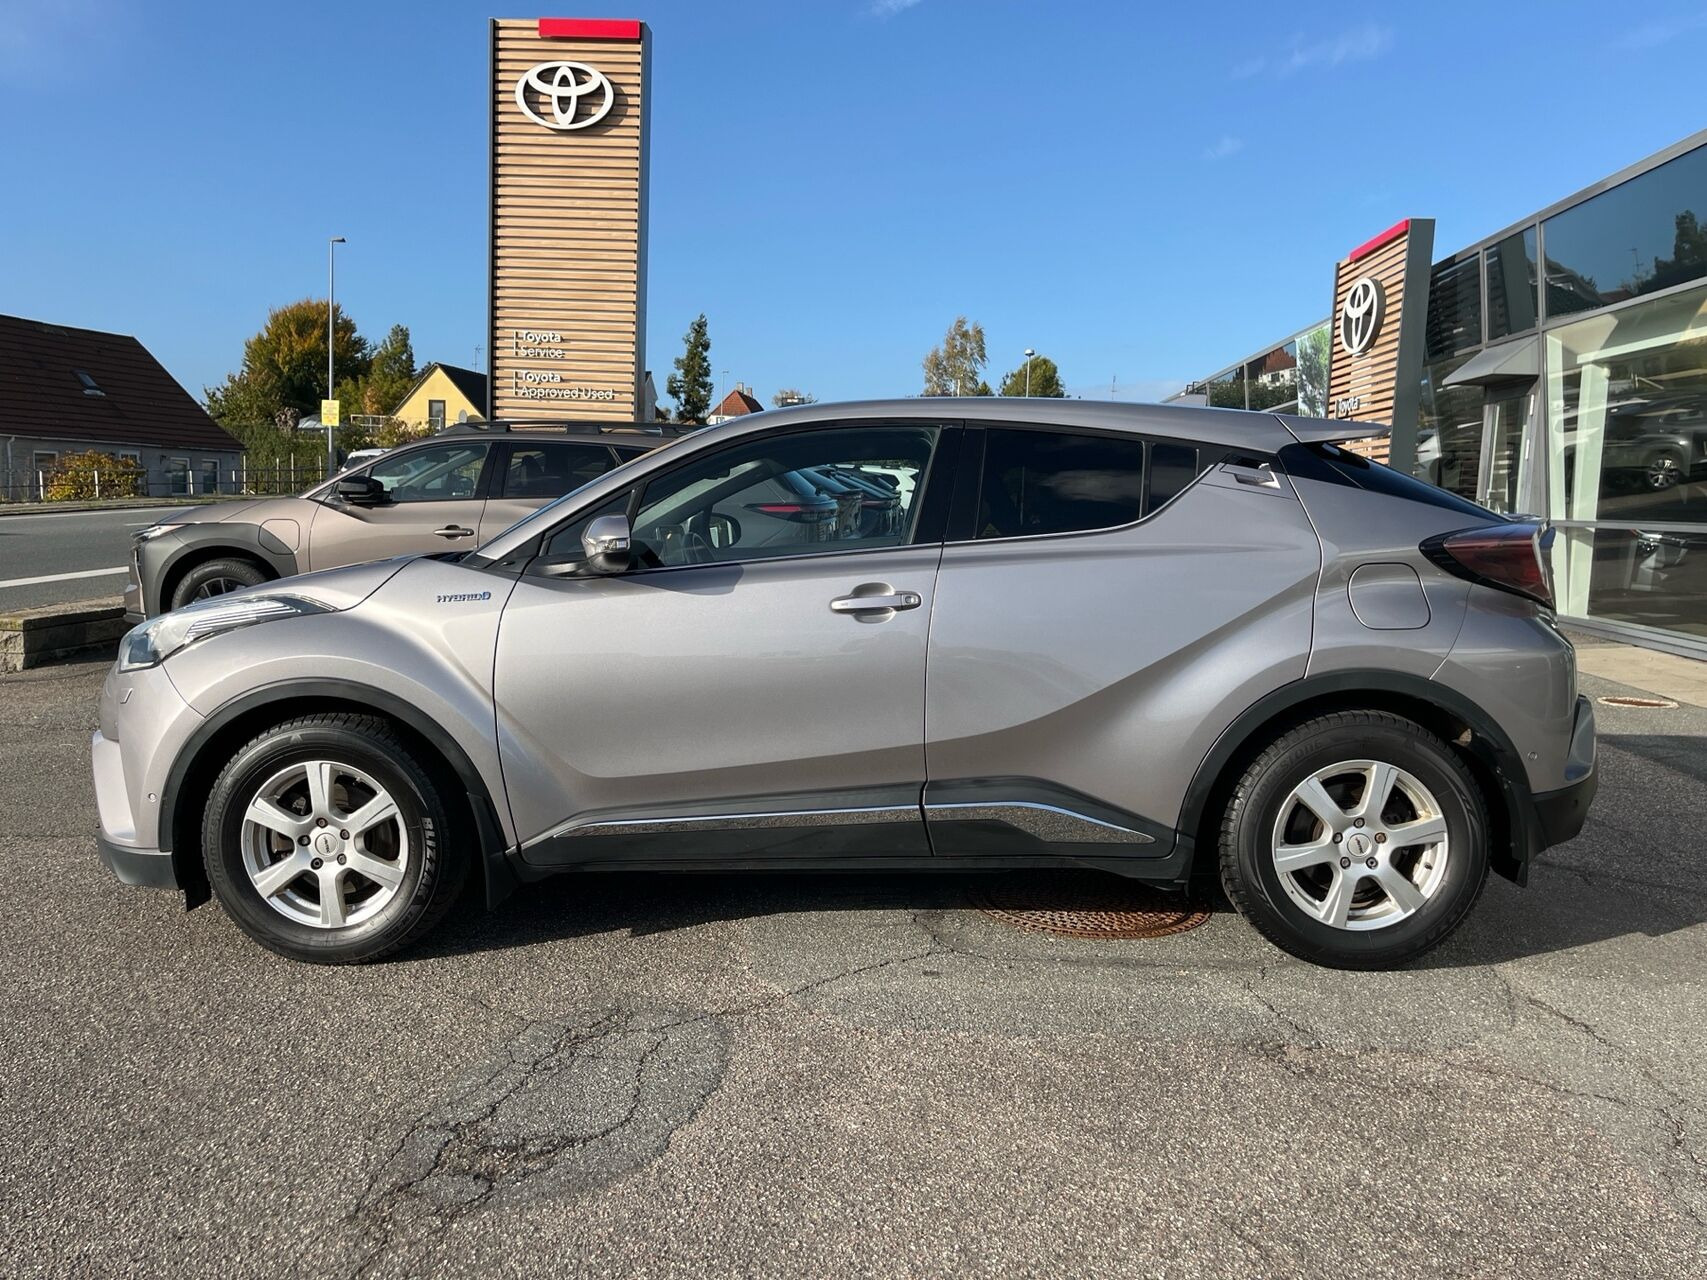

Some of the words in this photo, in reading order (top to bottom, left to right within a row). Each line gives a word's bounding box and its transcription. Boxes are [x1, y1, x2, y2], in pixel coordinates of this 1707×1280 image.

[521, 331, 561, 344] Toyota
[520, 345, 564, 358] Service
[521, 371, 561, 384] Toyota
[520, 386, 579, 401] Approved
[582, 388, 613, 400] Used
[1339, 396, 1359, 416] Toyota
[417, 817, 436, 900] BLIZZAK
